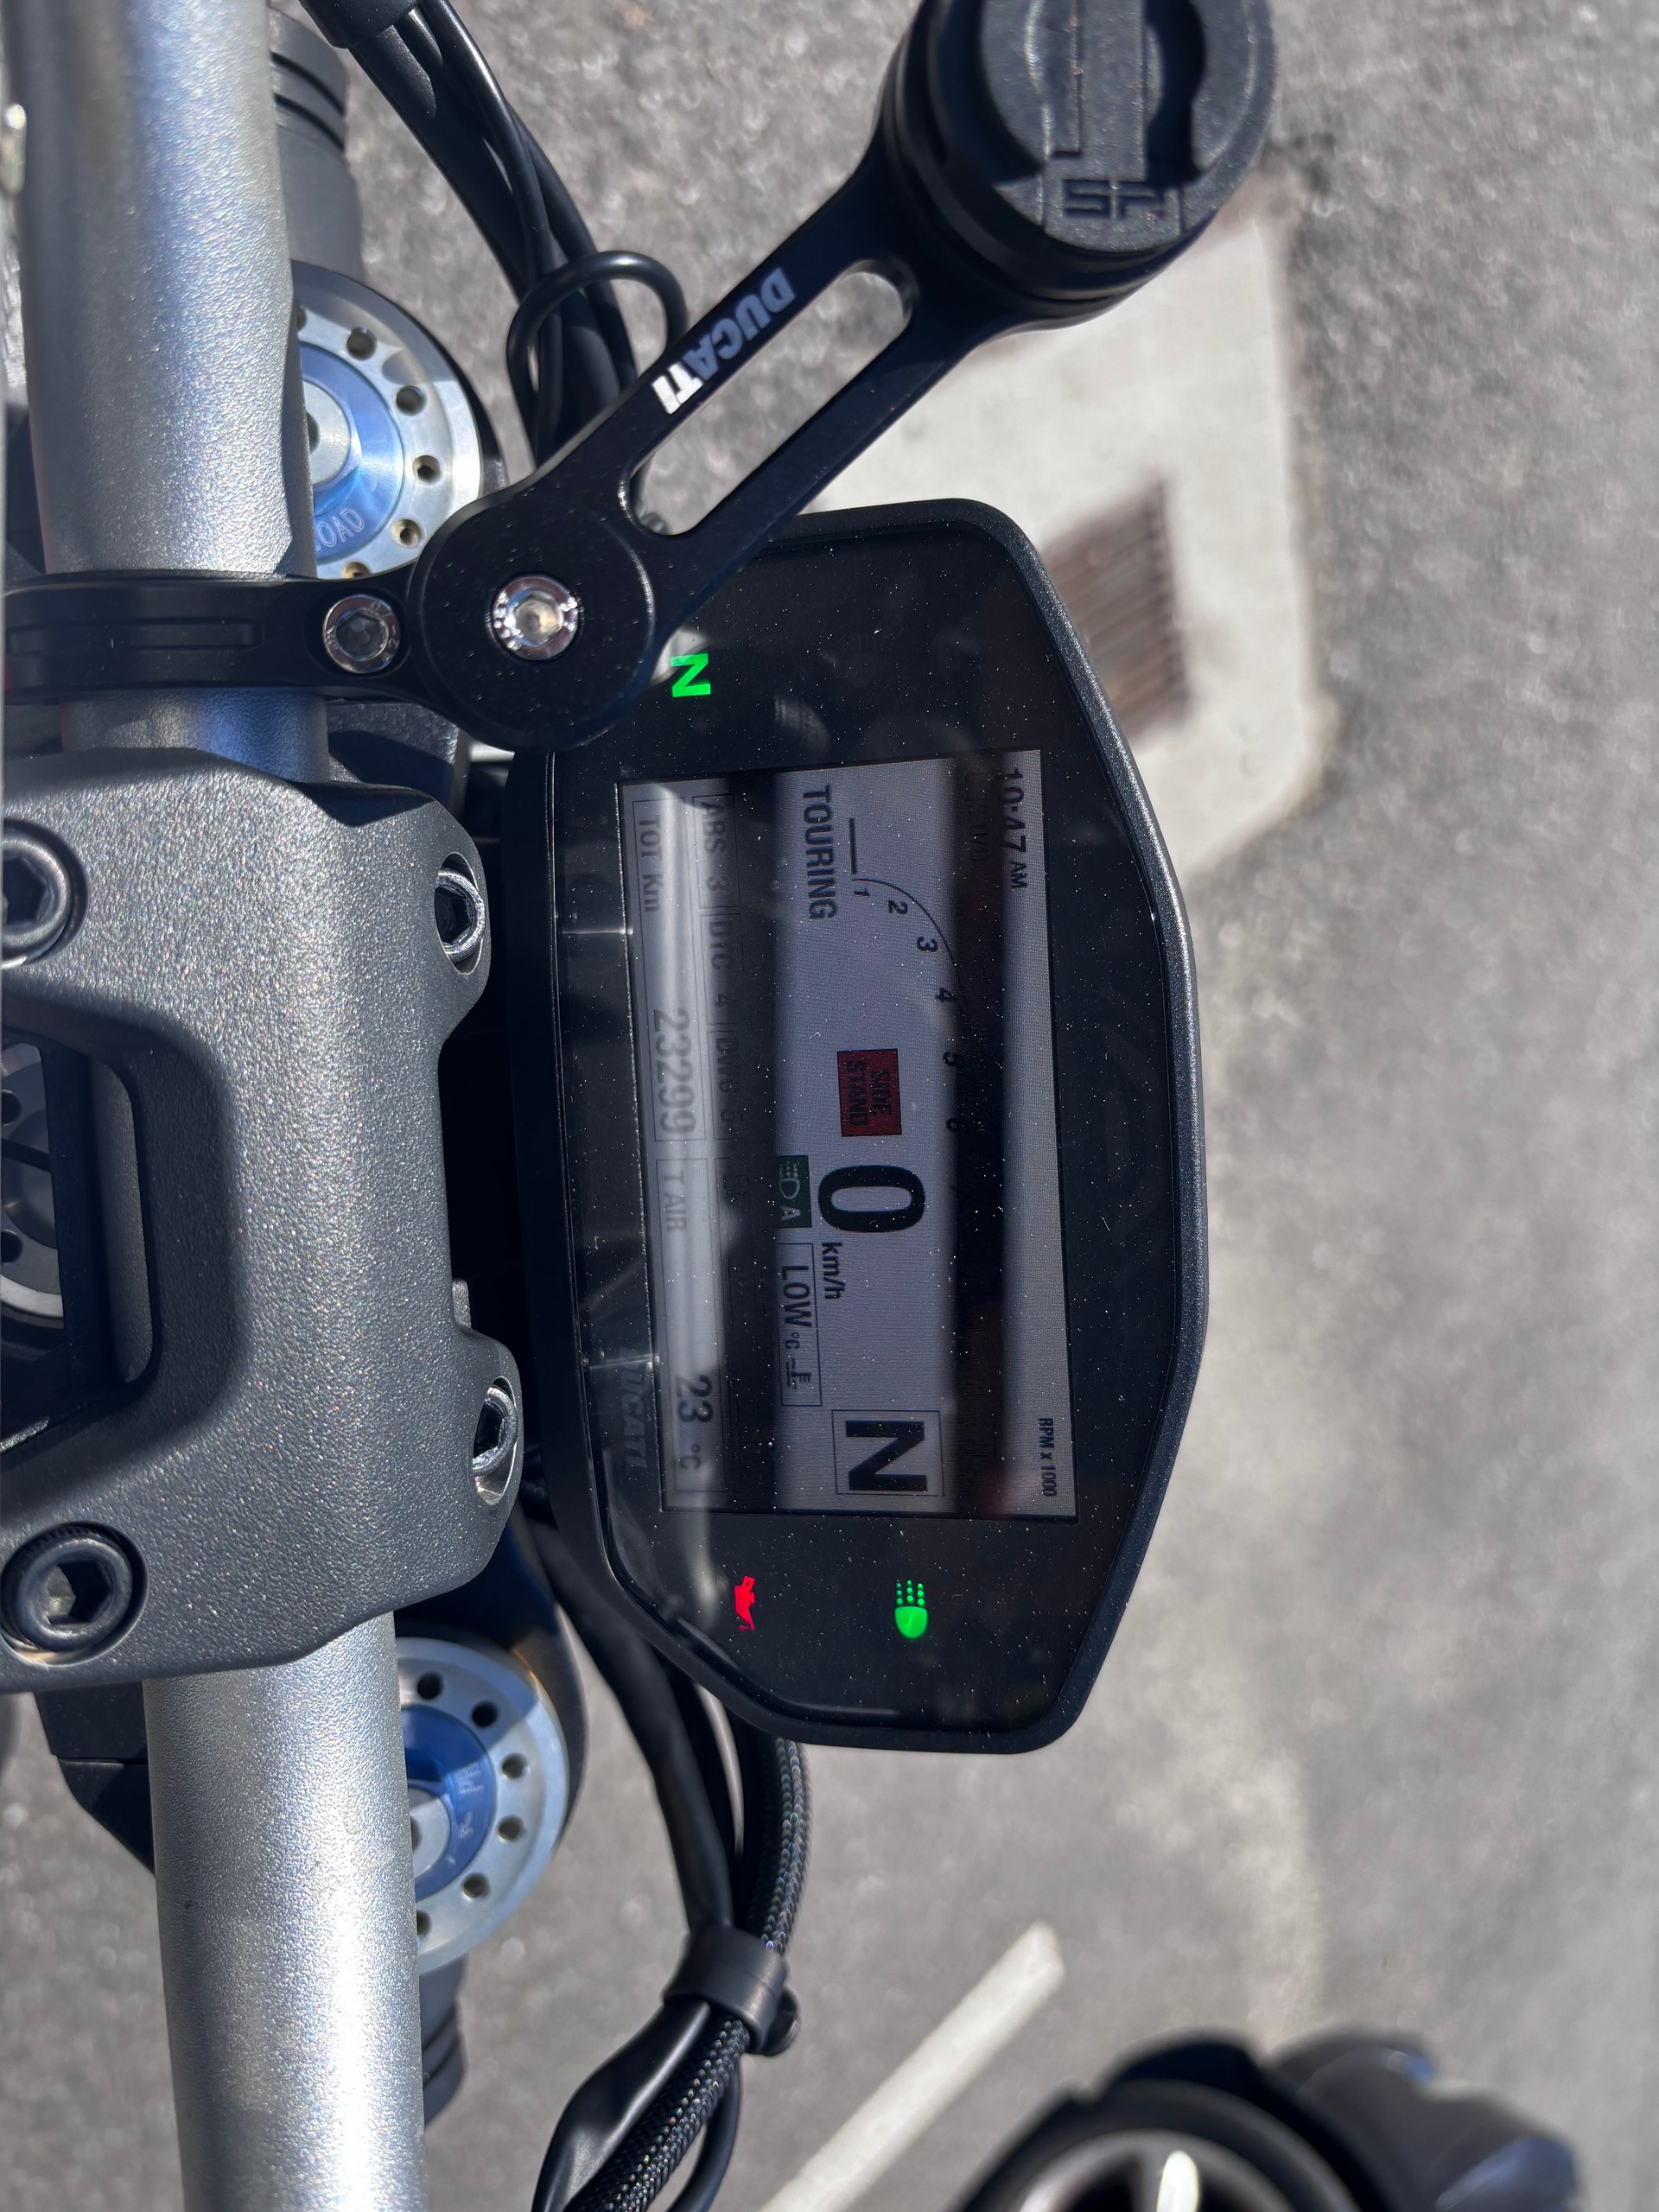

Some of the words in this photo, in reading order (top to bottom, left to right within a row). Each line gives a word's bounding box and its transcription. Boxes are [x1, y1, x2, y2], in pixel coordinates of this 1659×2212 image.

[652, 268, 796, 415] DUCATI
[315, 508, 365, 550] OAD
[671, 653, 711, 697] N
[639, 815, 662, 861] TOT
[701, 800, 728, 855] ABS
[803, 785, 837, 920] TOURING
[1011, 861, 1028, 889] AM
[854, 887, 871, 898] 1
[888, 899, 908, 916] 2
[917, 936, 938, 953] 3
[935, 987, 957, 1003] 4
[653, 1007, 697, 1135] 23299
[846, 1059, 869, 1127] STAND
[870, 1068, 892, 1117] SIDE
[664, 1192, 689, 1231] AIR
[817, 1164, 926, 1233] 0
[821, 1241, 847, 1300] km/h
[781, 1264, 812, 1327] LOW
[675, 1375, 715, 1423] 23
[844, 1420, 928, 1492] N
[1039, 1417, 1055, 1449] RPM
[1040, 1451, 1052, 1459] x
[1041, 1464, 1058, 1497] 1000
